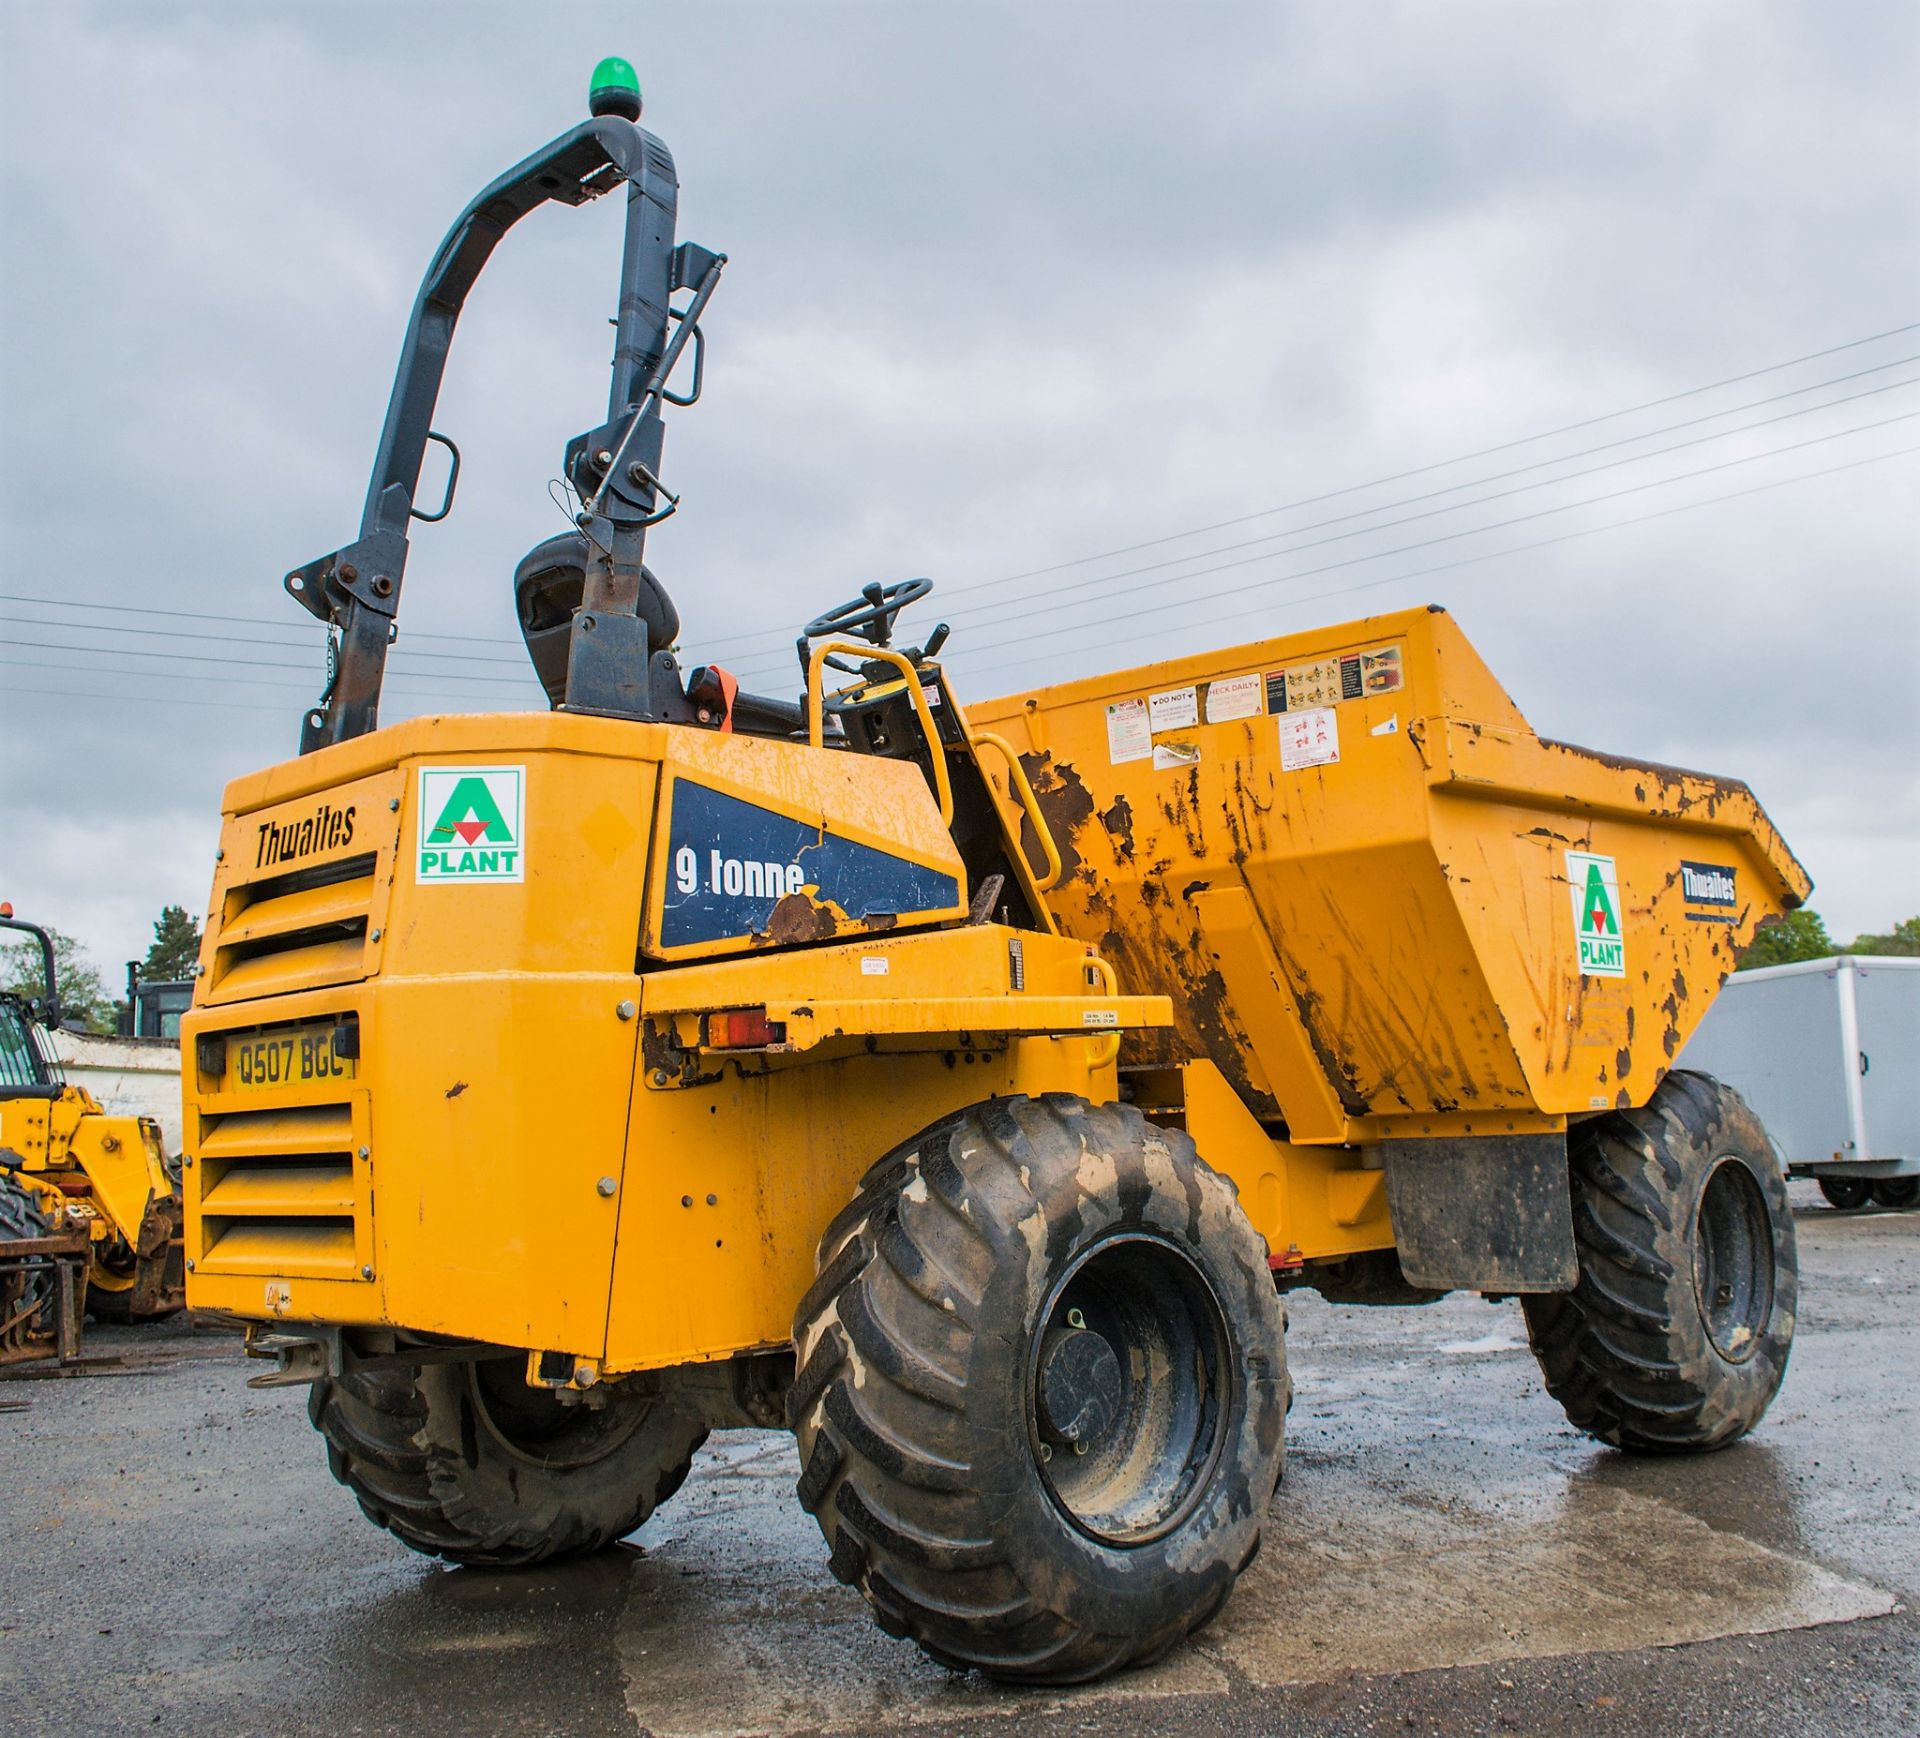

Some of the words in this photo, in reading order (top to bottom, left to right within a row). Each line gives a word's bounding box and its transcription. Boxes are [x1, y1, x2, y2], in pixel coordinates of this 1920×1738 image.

[1159, 696, 1170, 705] DO
[1171, 692, 1187, 703] NOT
[1208, 687, 1231, 696] HECK
[1232, 681, 1253, 692] DAILY
[256, 804, 356, 869] Thwaites
[421, 851, 519, 873] PLANT
[676, 846, 697, 894] 9
[711, 849, 805, 898] tonne
[1681, 867, 1735, 901] Thwaites
[1580, 941, 1623, 966] PLANT
[241, 1040, 294, 1085] Q507
